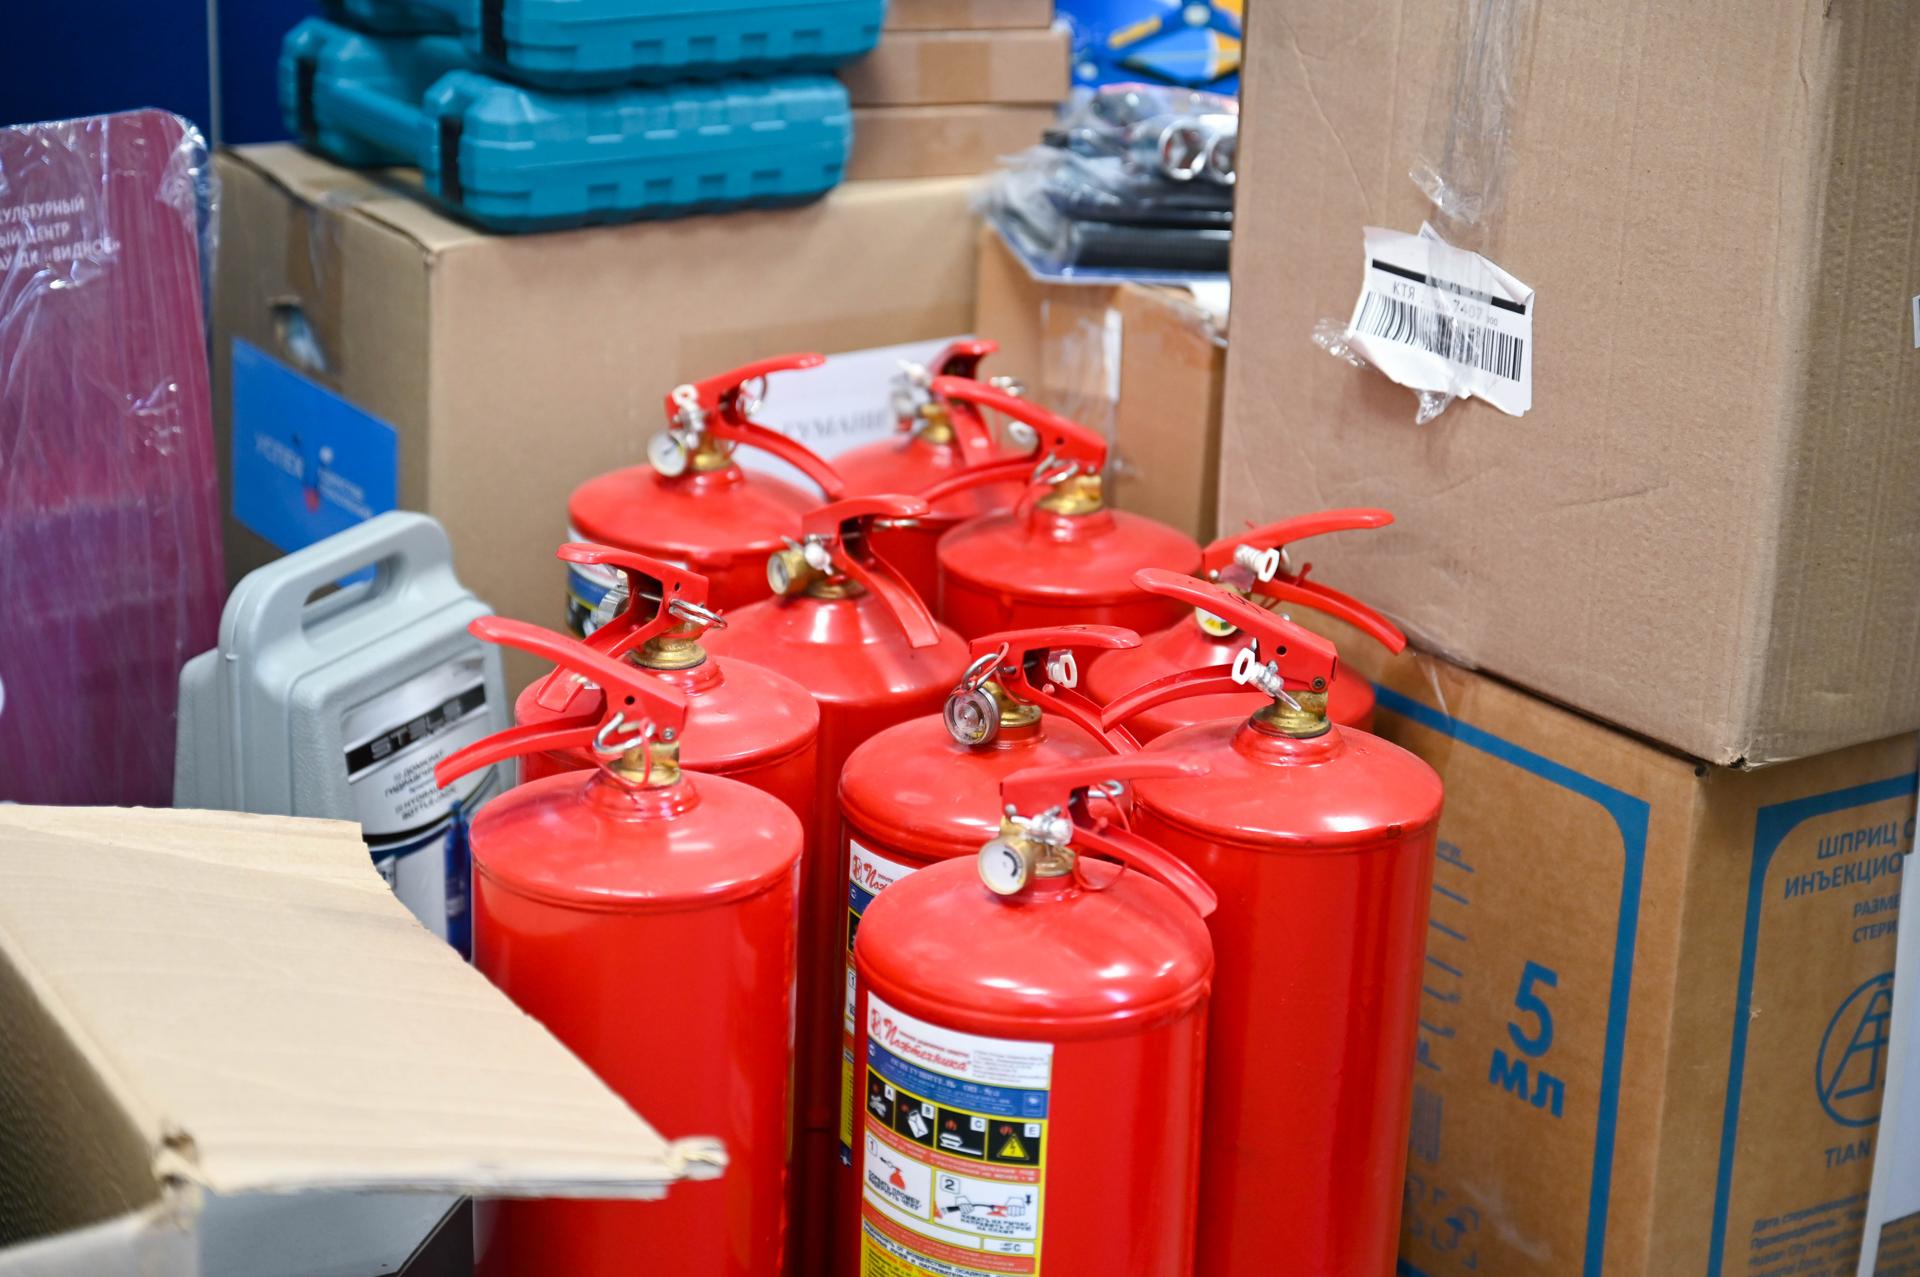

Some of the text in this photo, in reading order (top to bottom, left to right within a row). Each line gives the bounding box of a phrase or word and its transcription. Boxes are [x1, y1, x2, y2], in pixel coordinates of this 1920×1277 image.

[0, 196, 85, 225] УЛЬТУРНЫЙ
[1817, 821, 1898, 860] ШПРИЦ
[1784, 852, 1905, 900] ИНЪЕКЦИО
[1507, 959, 1558, 1058] 5
[887, 1088, 892, 1098] A
[1488, 1047, 1565, 1120] мл
[925, 1105, 931, 1115] B
[975, 1120, 983, 1129] C
[1029, 1126, 1036, 1135] E
[869, 1140, 874, 1152] 1
[1824, 1139, 1872, 1169] TIAN
[944, 1178, 955, 1191] 2
